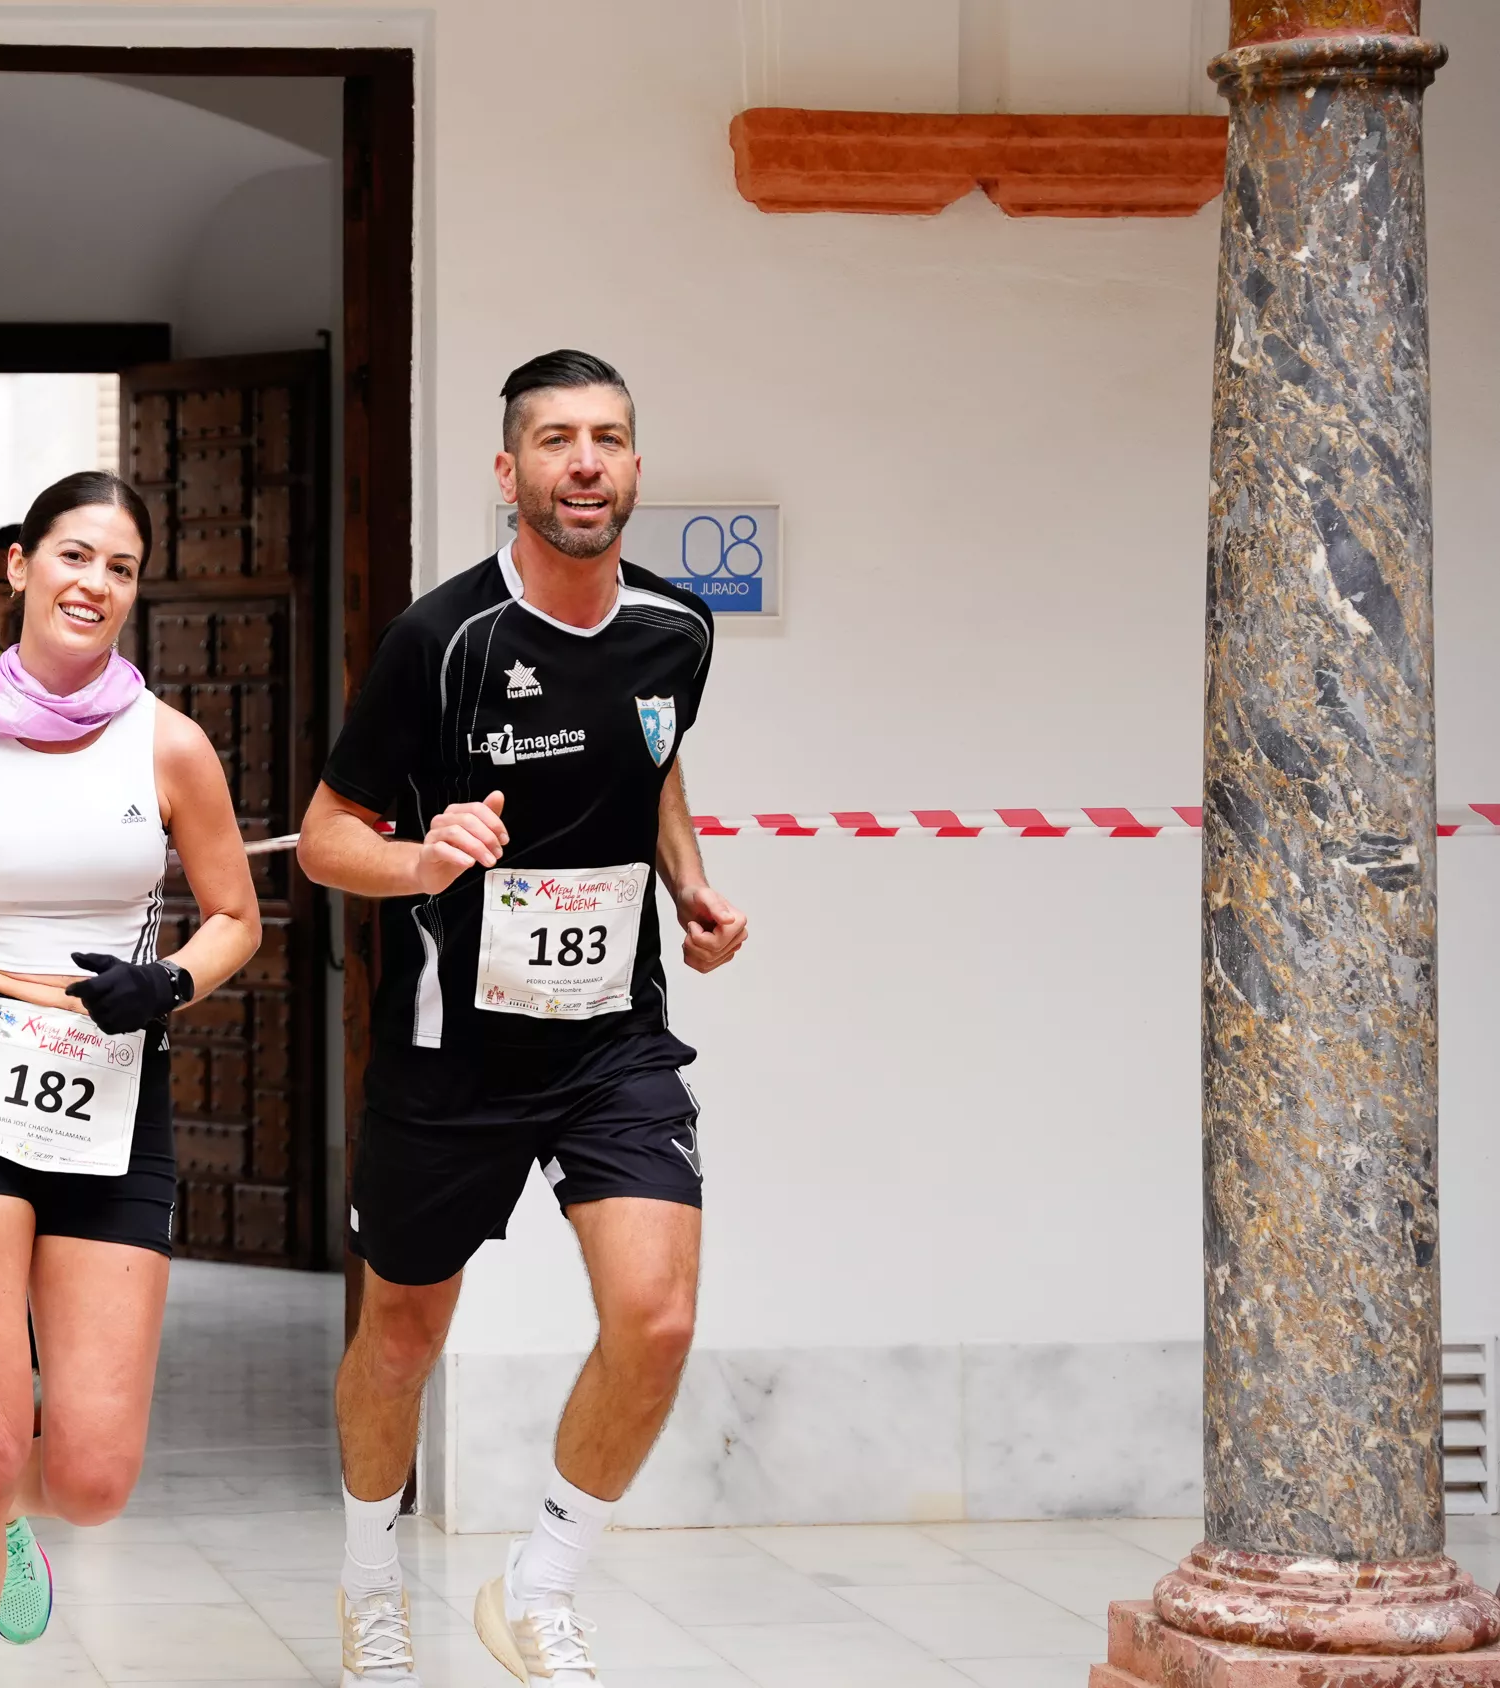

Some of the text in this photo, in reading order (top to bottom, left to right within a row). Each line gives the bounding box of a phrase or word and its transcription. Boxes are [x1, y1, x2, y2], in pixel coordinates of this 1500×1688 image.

[682, 515, 763, 577] 08
[671, 582, 749, 595] BEL JURADO
[506, 685, 543, 699] luanvi
[121, 816, 147, 824] adidas
[535, 878, 556, 900] X
[554, 896, 603, 912] LUCENA
[528, 924, 608, 967] 183
[547, 977, 572, 985] CHACÓN
[572, 976, 603, 985] SALAMANCA
[65, 1027, 103, 1047] MARATÓN
[39, 1035, 92, 1061] LUCENA
[3, 1064, 96, 1122] 182
[28, 1123, 54, 1134] CHACÓN
[55, 1128, 92, 1143] SALAMANCA
[547, 1497, 568, 1518] NIKE
